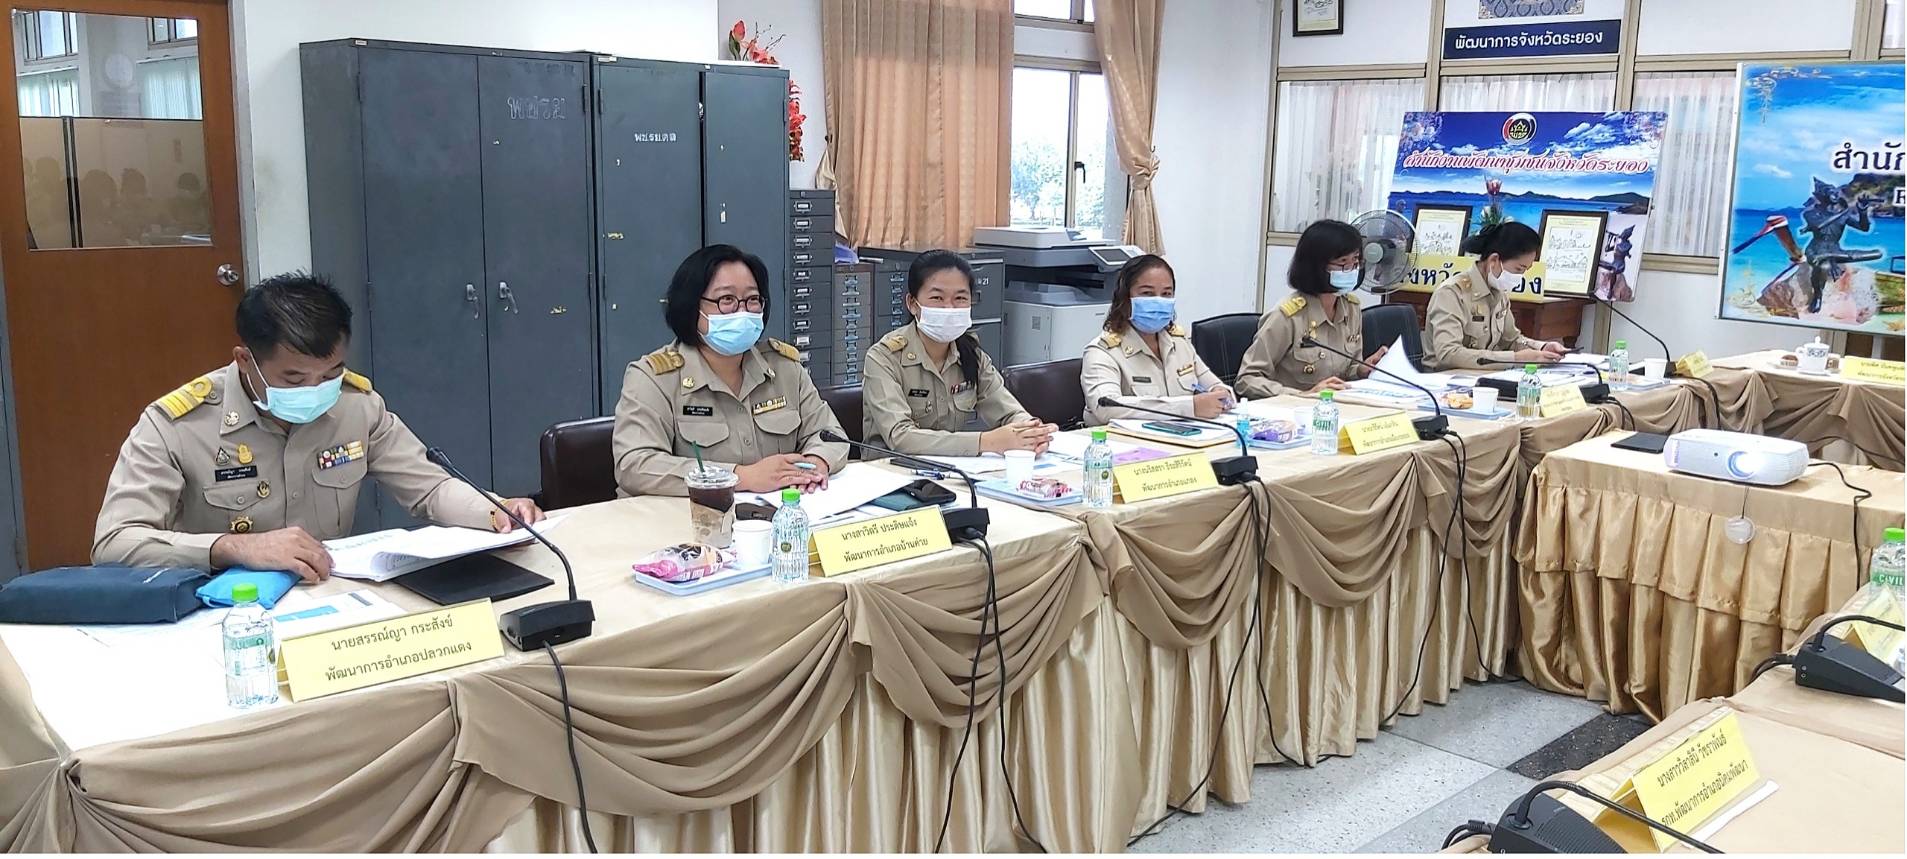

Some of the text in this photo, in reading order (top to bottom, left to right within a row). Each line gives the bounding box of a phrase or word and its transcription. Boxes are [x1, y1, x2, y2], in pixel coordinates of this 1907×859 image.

[1455, 31, 1603, 49] พัฒนาการจังหวัดระยอง
[331, 614, 453, 651] นายสรรณ์ญา กระสังข์
[325, 641, 472, 681] พัฒนาการอำเภอปลวกแดง
